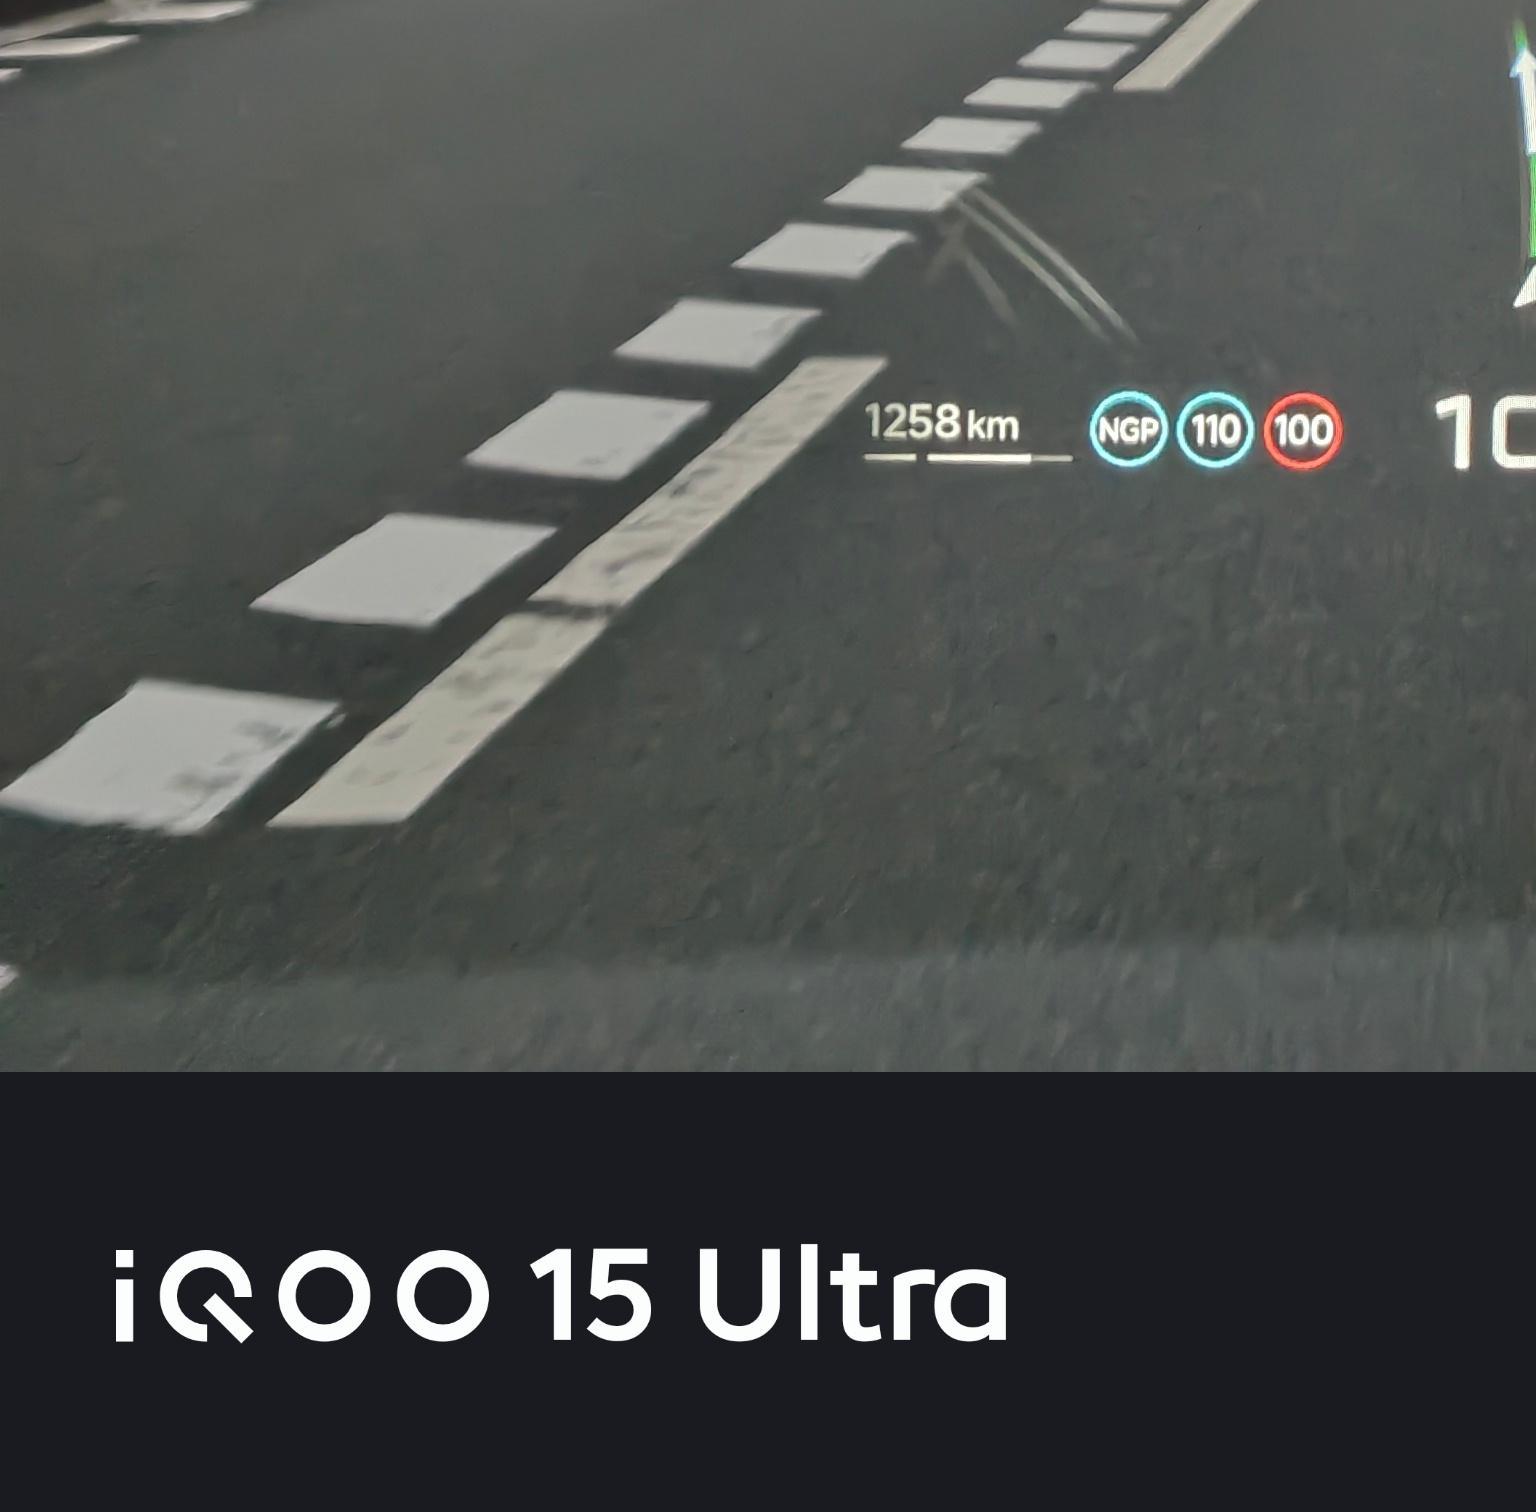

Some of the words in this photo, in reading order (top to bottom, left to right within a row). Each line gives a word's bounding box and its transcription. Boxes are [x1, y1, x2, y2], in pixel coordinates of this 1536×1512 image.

[1099, 415, 1160, 444] NGP
[1191, 413, 1241, 446] 110
[1274, 413, 1333, 446] 100
